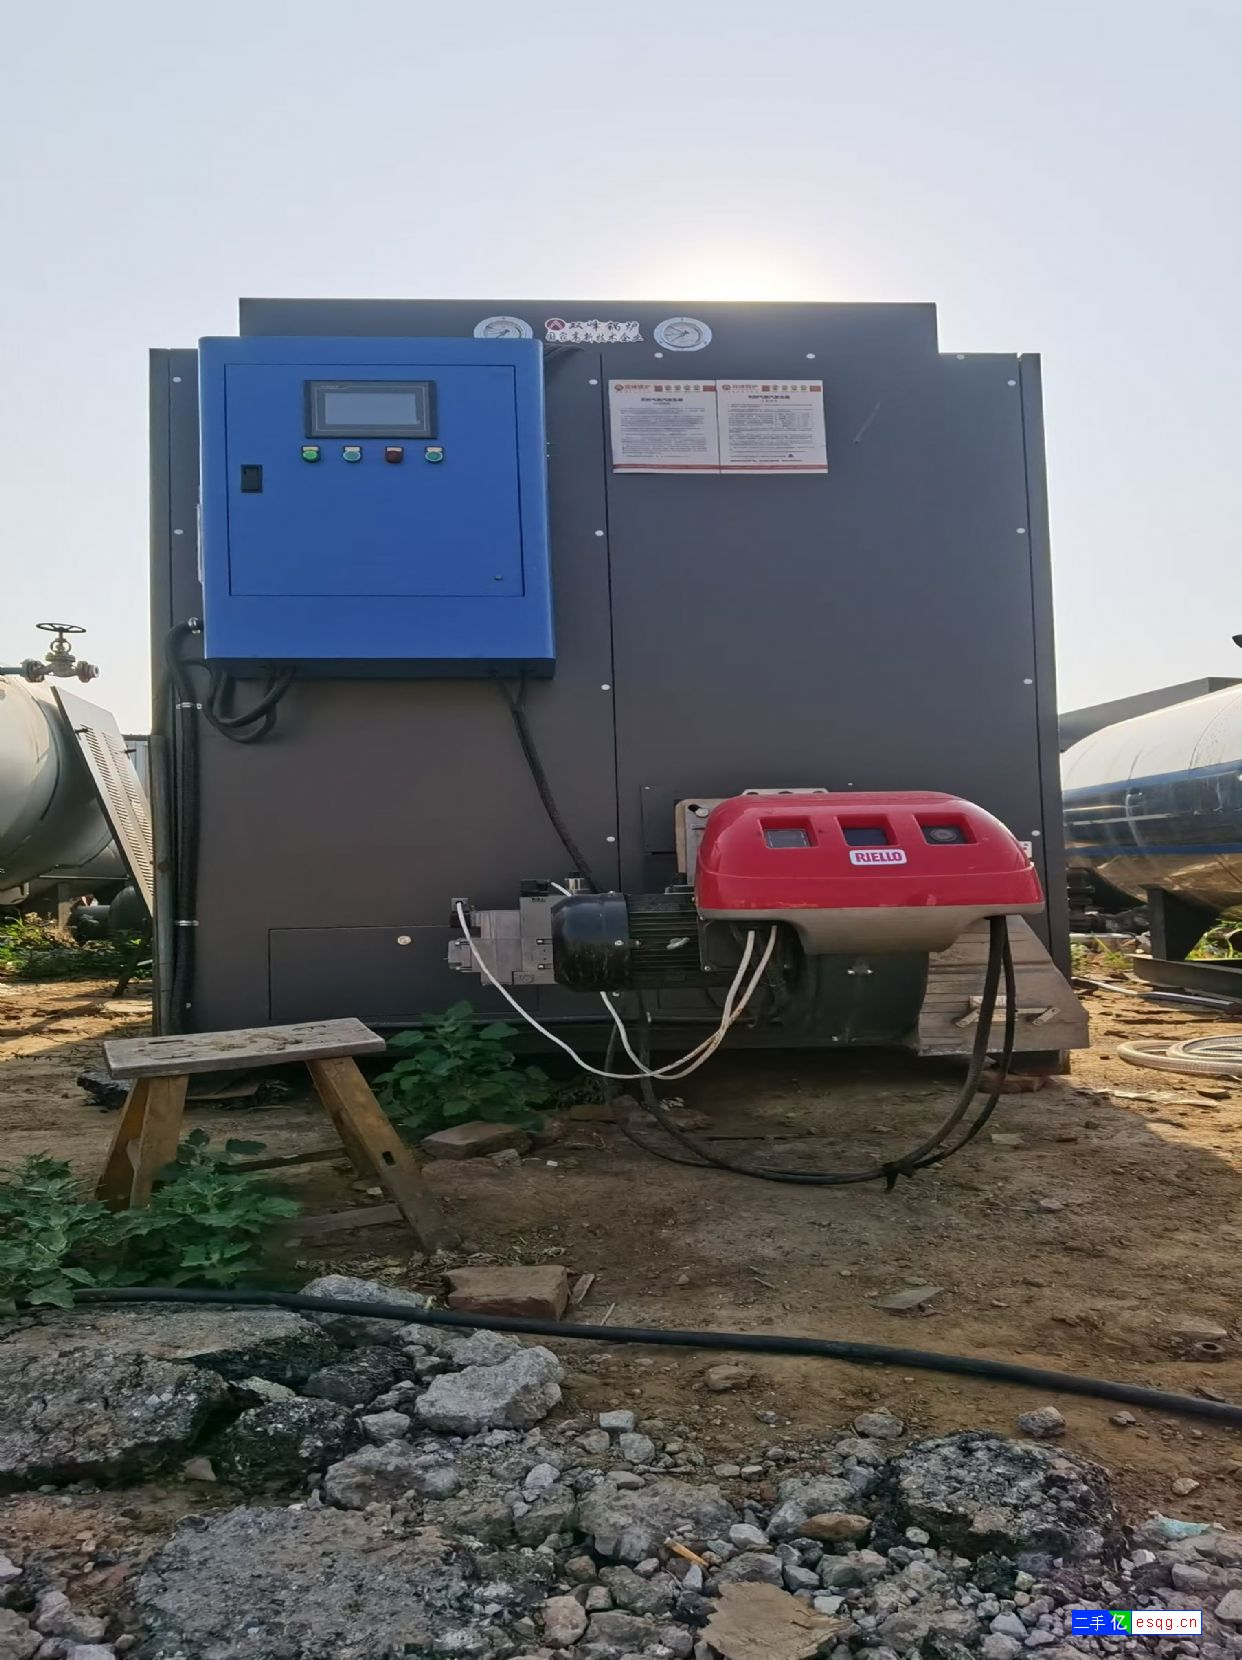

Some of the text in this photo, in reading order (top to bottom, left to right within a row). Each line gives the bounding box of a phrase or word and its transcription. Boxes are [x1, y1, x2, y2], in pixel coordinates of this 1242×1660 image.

[568, 319, 639, 332] 双峰锅炉
[546, 331, 643, 343] 国家高新技术企业
[854, 851, 903, 863] RIELLO
